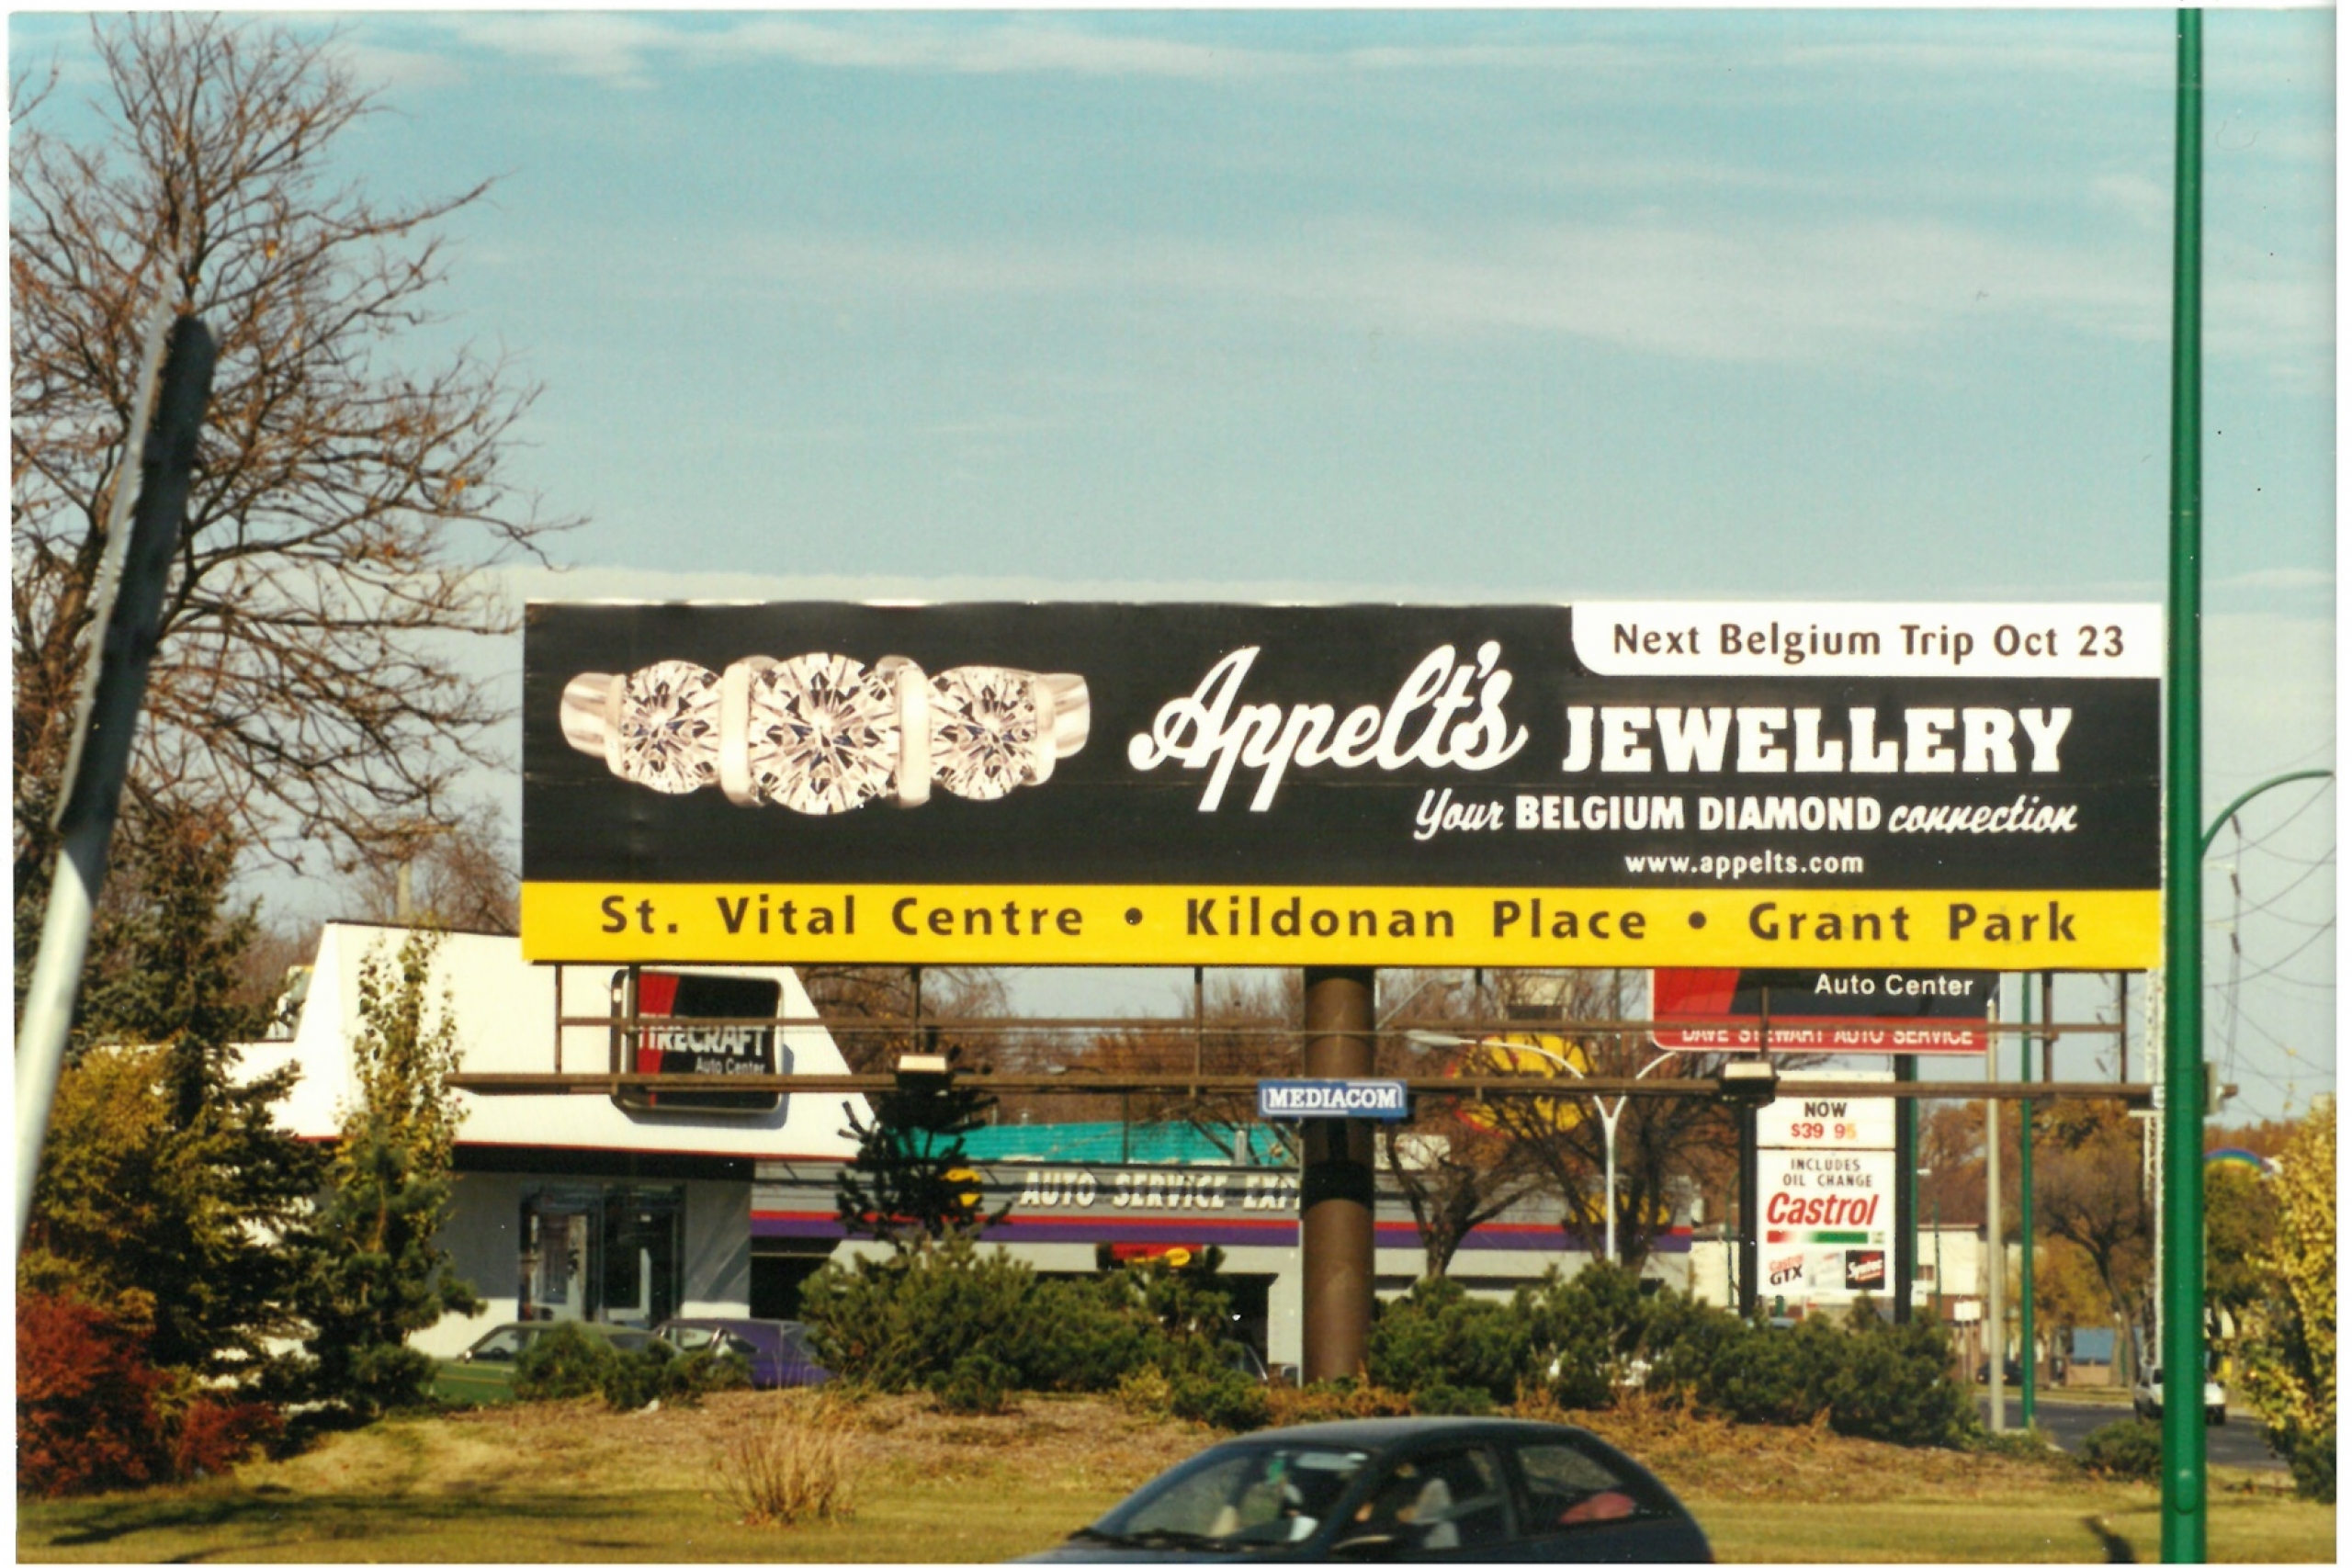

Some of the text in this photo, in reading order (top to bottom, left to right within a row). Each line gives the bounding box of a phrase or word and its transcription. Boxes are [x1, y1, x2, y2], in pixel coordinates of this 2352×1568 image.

[1613, 622, 2125, 666] Next Belgium Trip Oct 23
[1127, 640, 2074, 812] Appelt's JEWELLERY
[1413, 787, 2079, 840] Your BELGIUM DIAMOND connection
[1624, 849, 1865, 880] www.appelts.com
[600, 893, 2077, 943] St. Vital Centre Kildonan Place Grant Park
[1814, 972, 1974, 997] Auto Center
[1268, 1088, 1397, 1109] MEDIACOM
[1804, 1101, 1848, 1118] NOW
[1790, 1157, 1861, 1172] INCLUDES
[1019, 1171, 1301, 1211] AUTO SERVICE EXP
[1781, 1172, 1873, 1189] OIL CHANGE
[1766, 1190, 1880, 1226] Castrol
[1770, 1264, 1803, 1285] GTX
